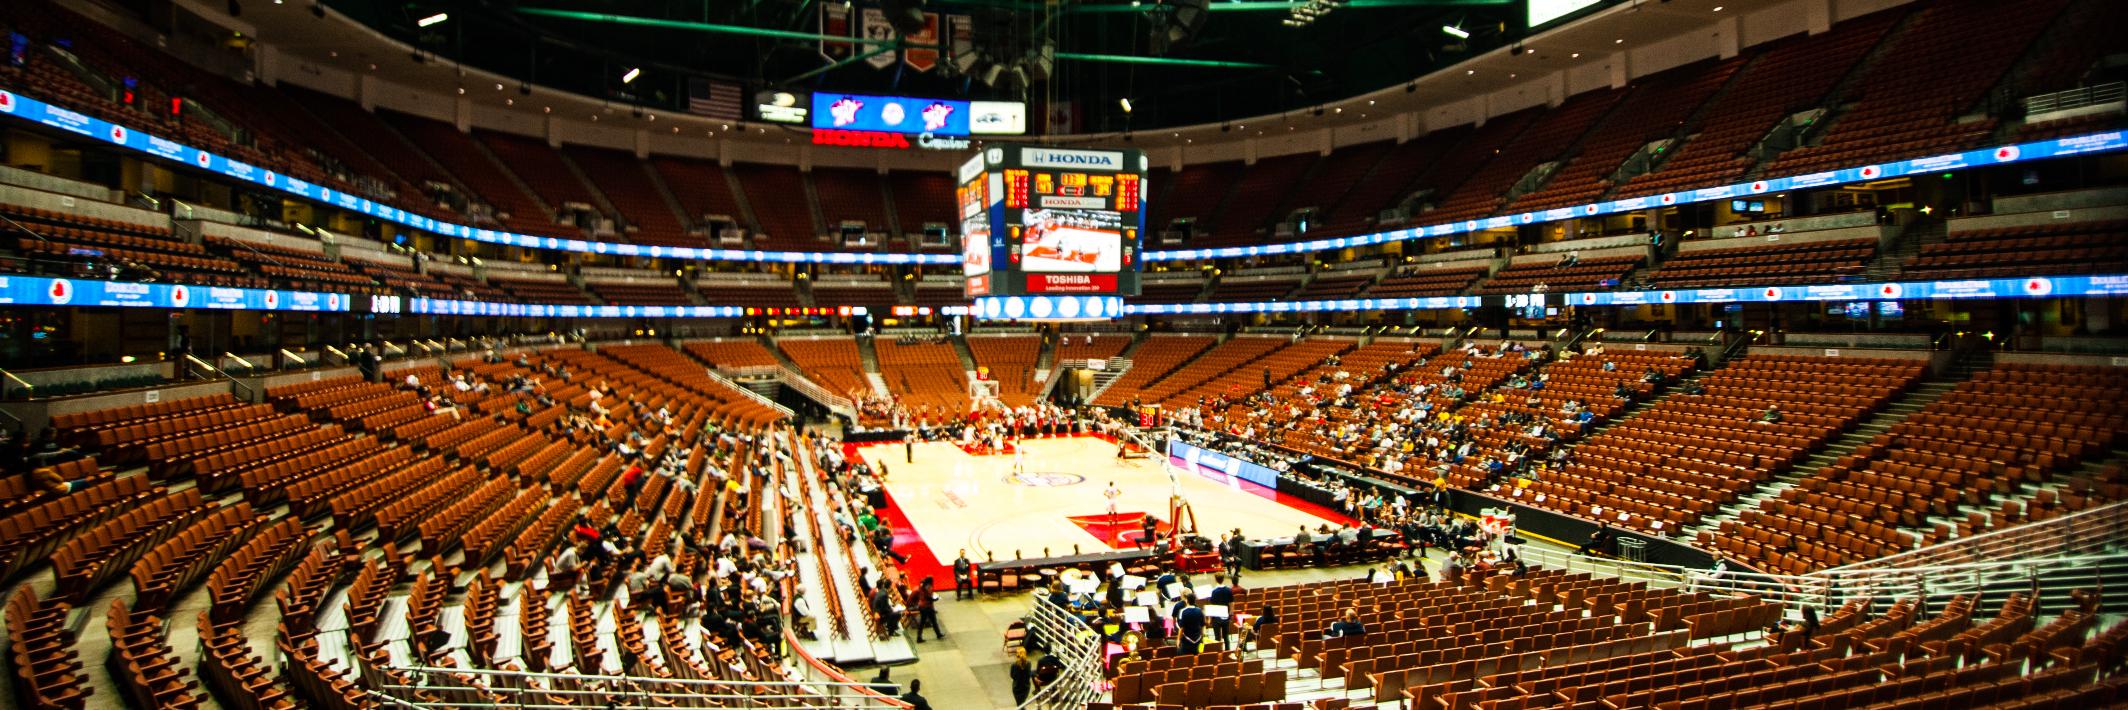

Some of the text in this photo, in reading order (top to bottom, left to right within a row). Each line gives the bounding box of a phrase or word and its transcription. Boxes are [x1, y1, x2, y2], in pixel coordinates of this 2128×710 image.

[812, 129, 910, 148] HONDA
[1049, 153, 1112, 165] HONDA
[1044, 198, 1082, 206] HONDA
[1045, 275, 1091, 284] TOSHIBA
